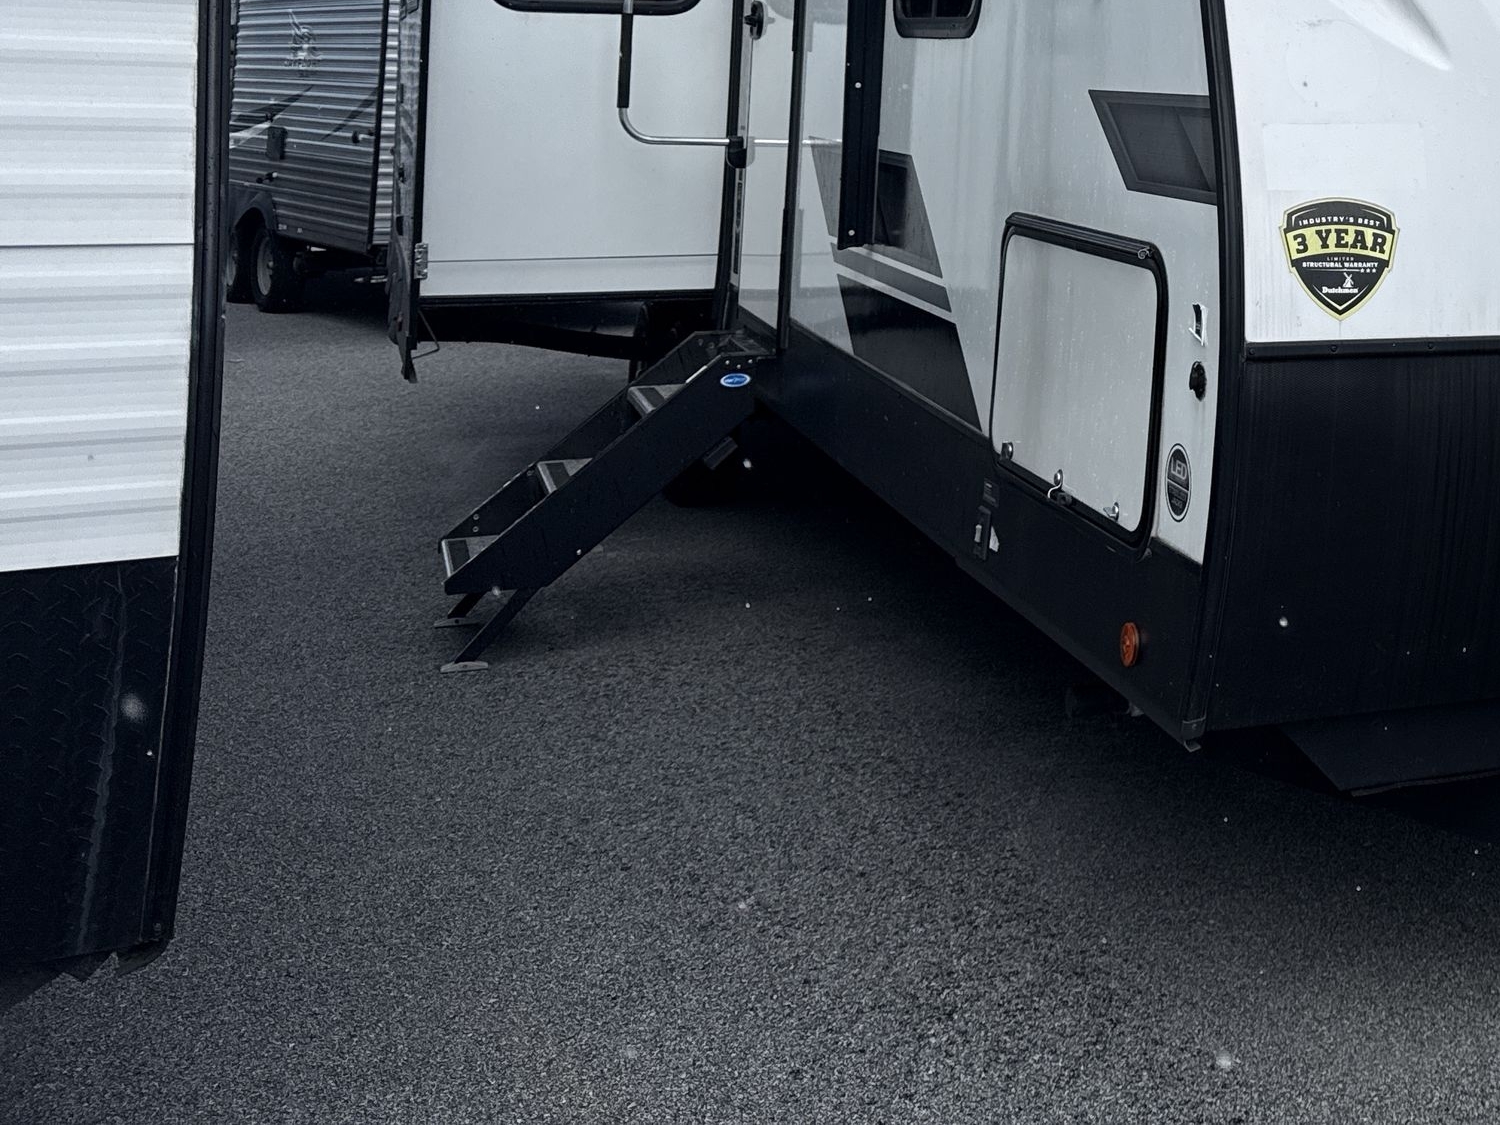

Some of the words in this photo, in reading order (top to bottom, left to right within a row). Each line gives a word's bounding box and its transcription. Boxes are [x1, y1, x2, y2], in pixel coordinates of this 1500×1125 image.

[1299, 216, 1354, 226] INDUSTRY'S
[1358, 217, 1381, 227] BEST
[1293, 233, 1309, 254] 3
[1315, 228, 1388, 254] YEAR
[1322, 286, 1359, 294] Dutchmen
[1171, 457, 1187, 480] LED
